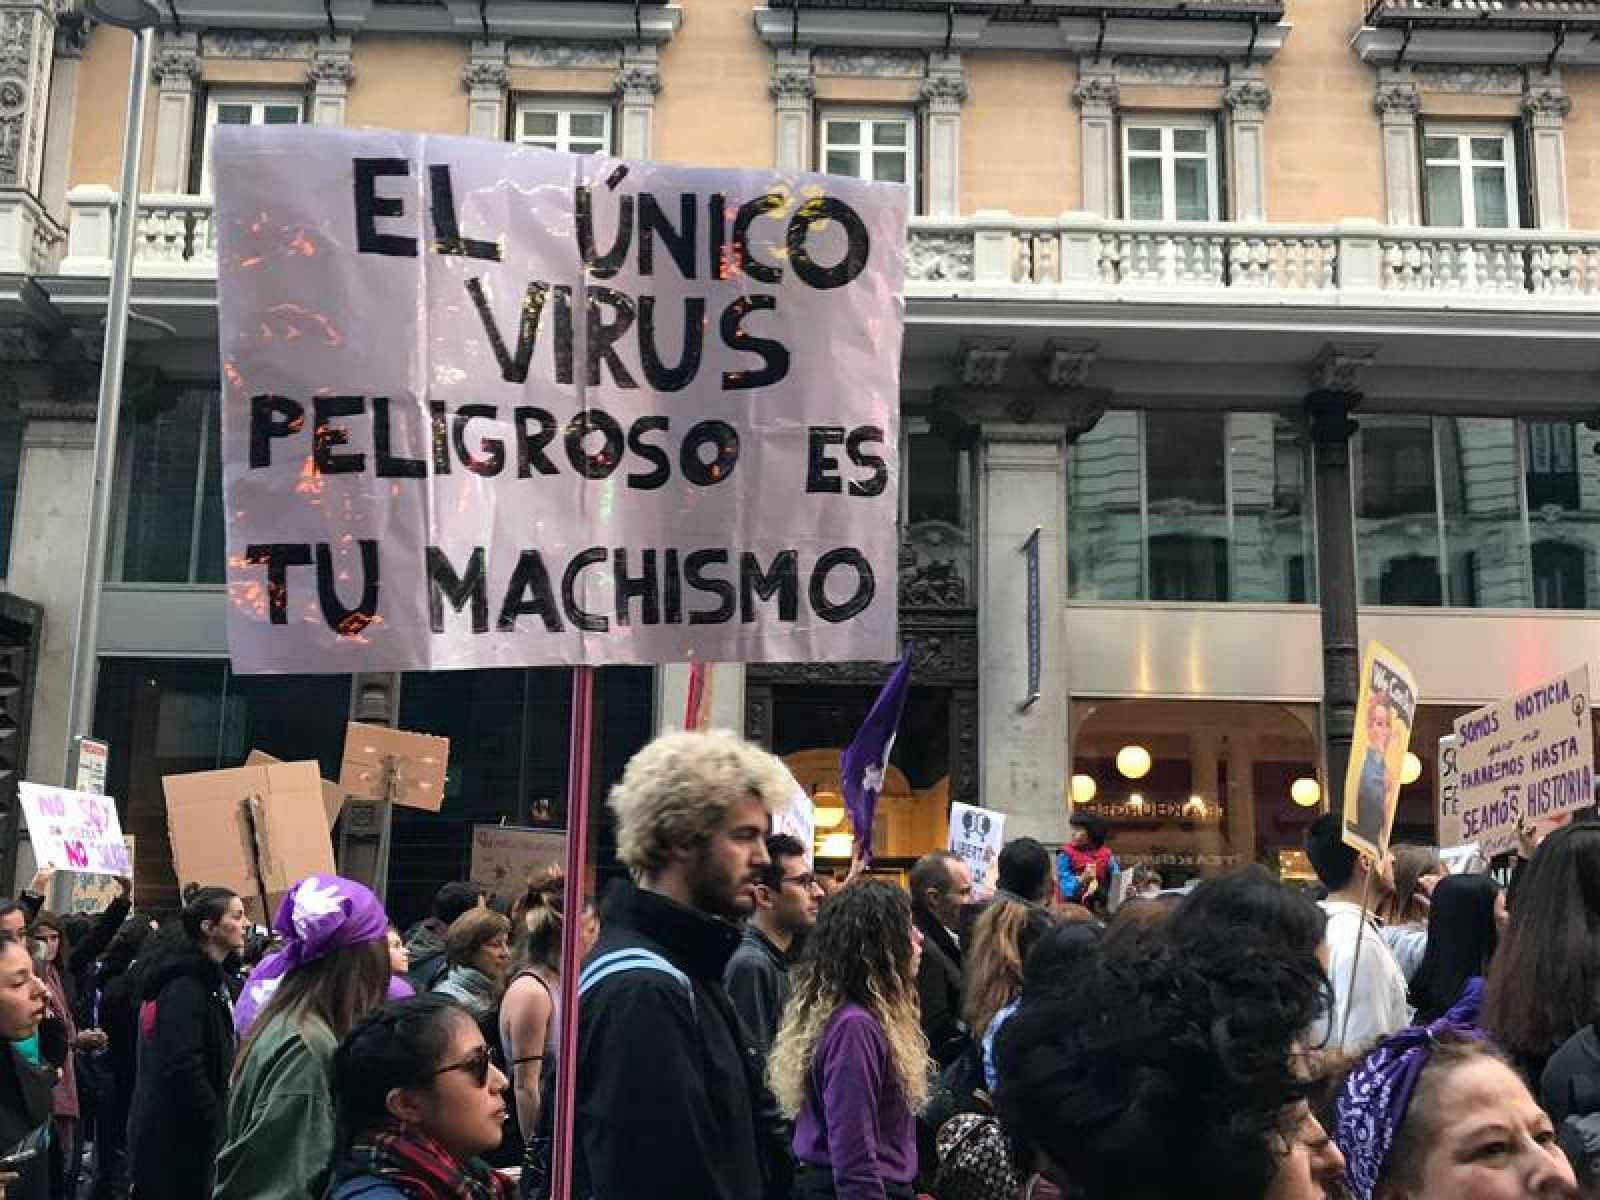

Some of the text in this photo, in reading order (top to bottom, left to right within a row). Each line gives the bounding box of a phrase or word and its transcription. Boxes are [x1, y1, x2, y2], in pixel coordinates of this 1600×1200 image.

[353, 157, 870, 291] EL ÚNICO
[464, 276, 791, 394] VIRUS
[249, 394, 888, 497] PELIGROSO ES
[246, 539, 876, 638] TU MACHISMO
[1460, 679, 1570, 748] SOMOS NOTICIA
[1531, 735, 1578, 771] HASTA
[1463, 765, 1591, 839] SEAMOS HISTORIA
